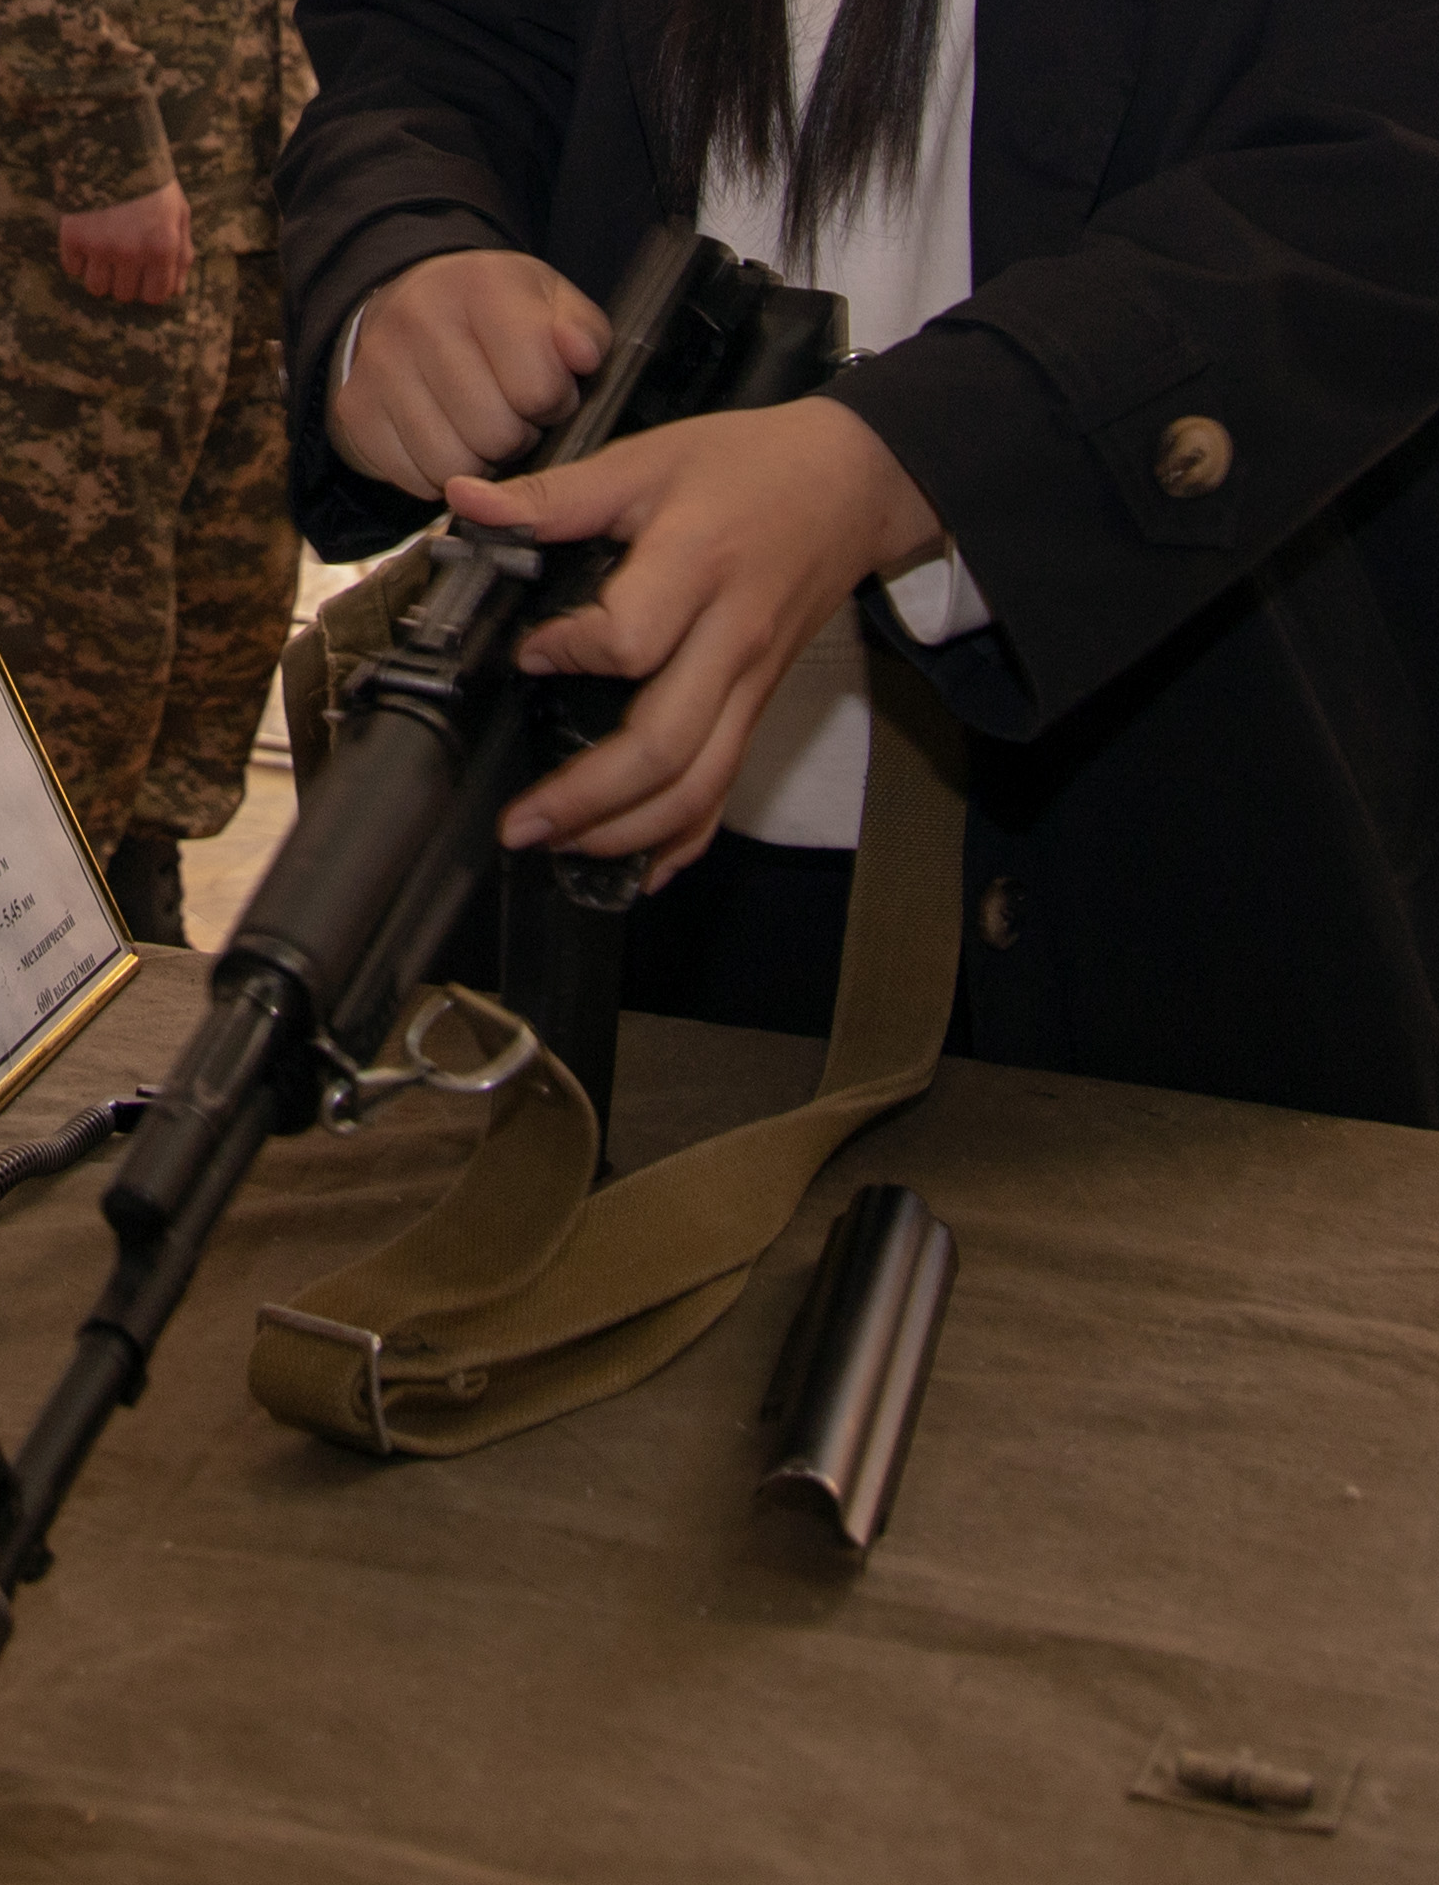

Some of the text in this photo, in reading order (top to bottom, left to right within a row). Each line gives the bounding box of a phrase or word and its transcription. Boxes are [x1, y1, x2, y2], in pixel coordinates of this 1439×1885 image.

[0, 858, 9, 871] м
[21, 893, 35, 912] мм
[20, 910, 75, 971] механический
[53, 954, 96, 1000] выстр/мин
